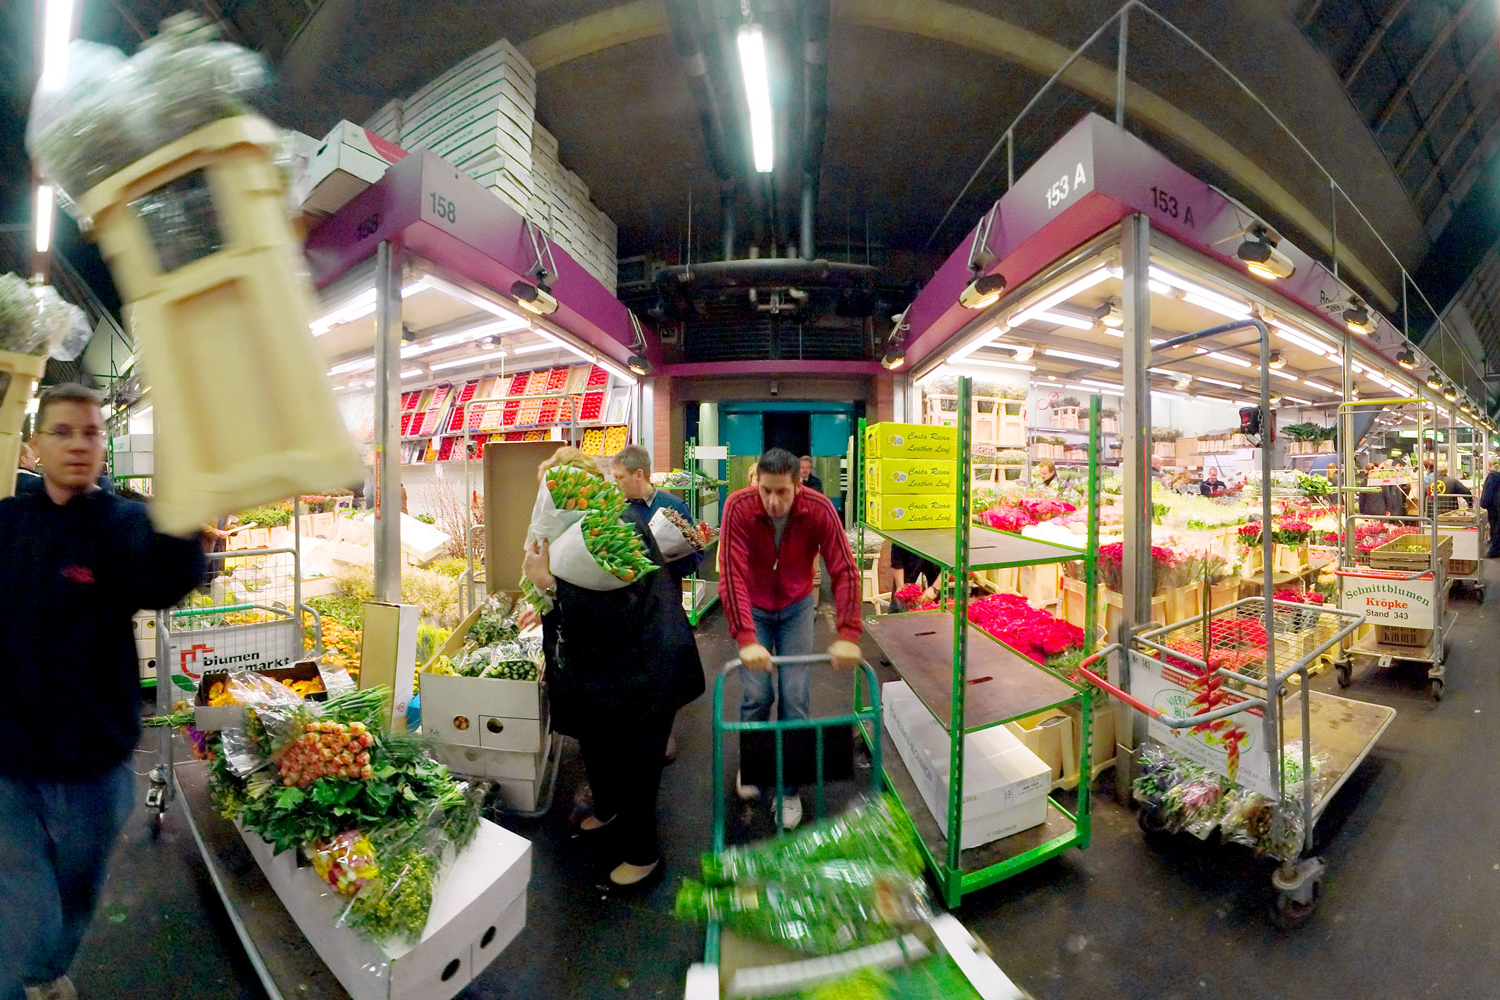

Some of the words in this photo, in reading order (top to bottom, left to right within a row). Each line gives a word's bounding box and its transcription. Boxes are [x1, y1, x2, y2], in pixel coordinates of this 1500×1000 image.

[1046, 175, 1069, 209] 153
[1073, 162, 1087, 190] A
[430, 192, 456, 223] 158
[1151, 186, 1178, 218] 153
[1183, 206, 1195, 229] A
[908, 432, 927, 440] Costa
[931, 433, 950, 441] Rican
[907, 444, 932, 452] Leather
[935, 445, 951, 454] Leaf
[908, 467, 927, 476] Costa
[931, 467, 950, 475] Rican
[935, 480, 951, 488] Leaf
[908, 502, 927, 511] Costa
[931, 501, 950, 509] Rican
[908, 514, 933, 522] Leather
[935, 513, 952, 522] Leaf
[1345, 584, 1430, 607] Schnittblumen
[1366, 597, 1409, 610] Kröpke
[1365, 609, 1389, 618] Stand
[1393, 611, 1409, 620] 343
